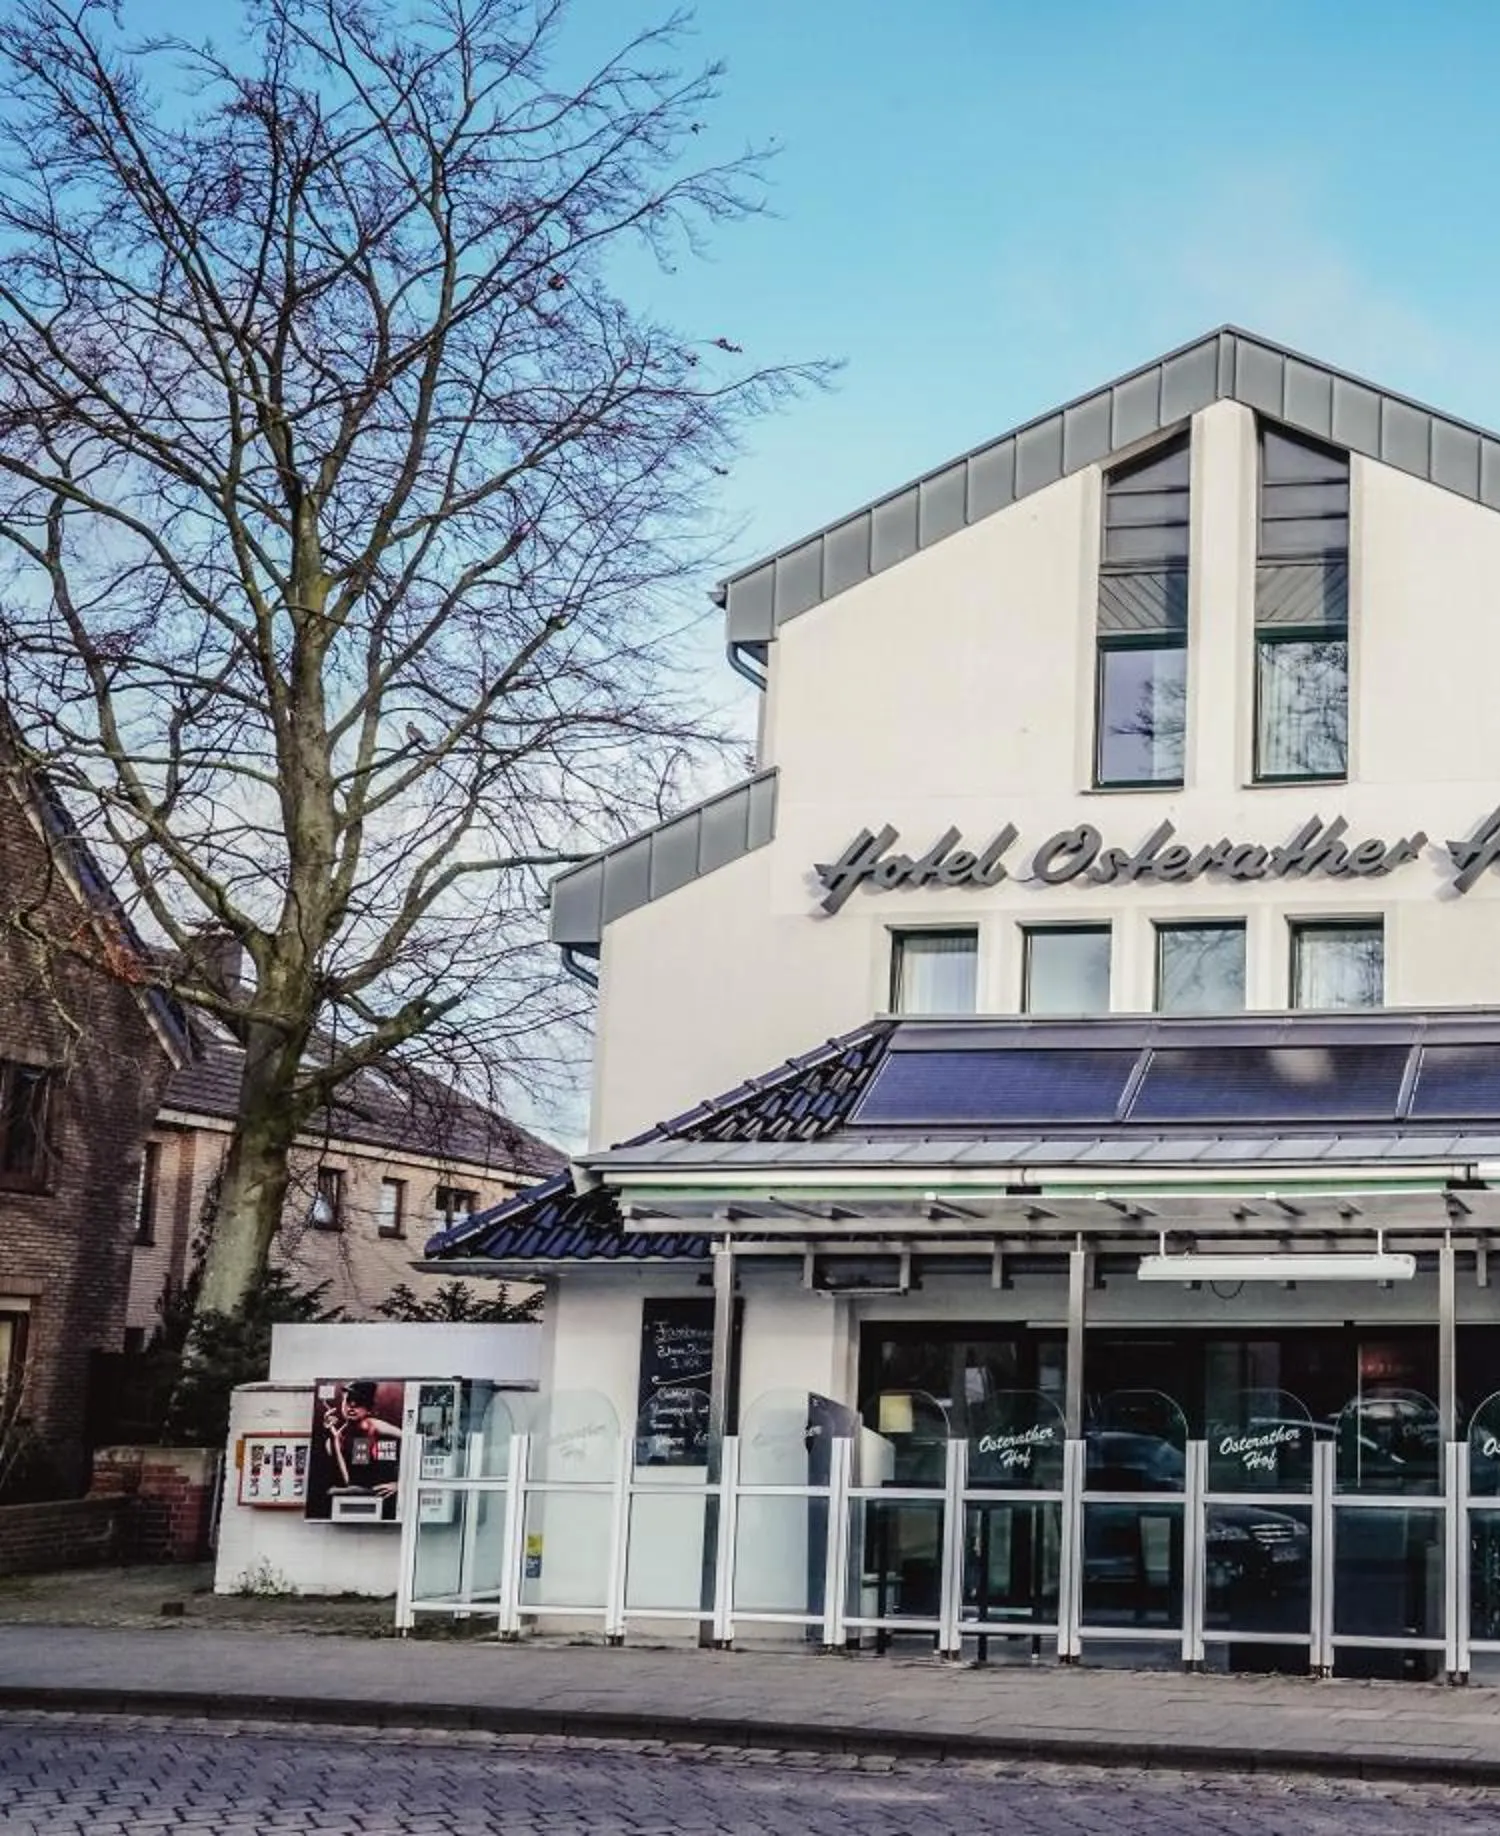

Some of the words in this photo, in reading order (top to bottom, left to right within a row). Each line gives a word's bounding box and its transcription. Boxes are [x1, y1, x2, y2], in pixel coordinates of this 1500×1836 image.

[814, 822, 1020, 915] Hotel
[1030, 814, 1428, 884] Osterather
[979, 1426, 1054, 1452] Osterather
[1219, 1426, 1301, 1456] Osterather
[1000, 1448, 1031, 1470] Hof
[1242, 1448, 1278, 1472] Hof
